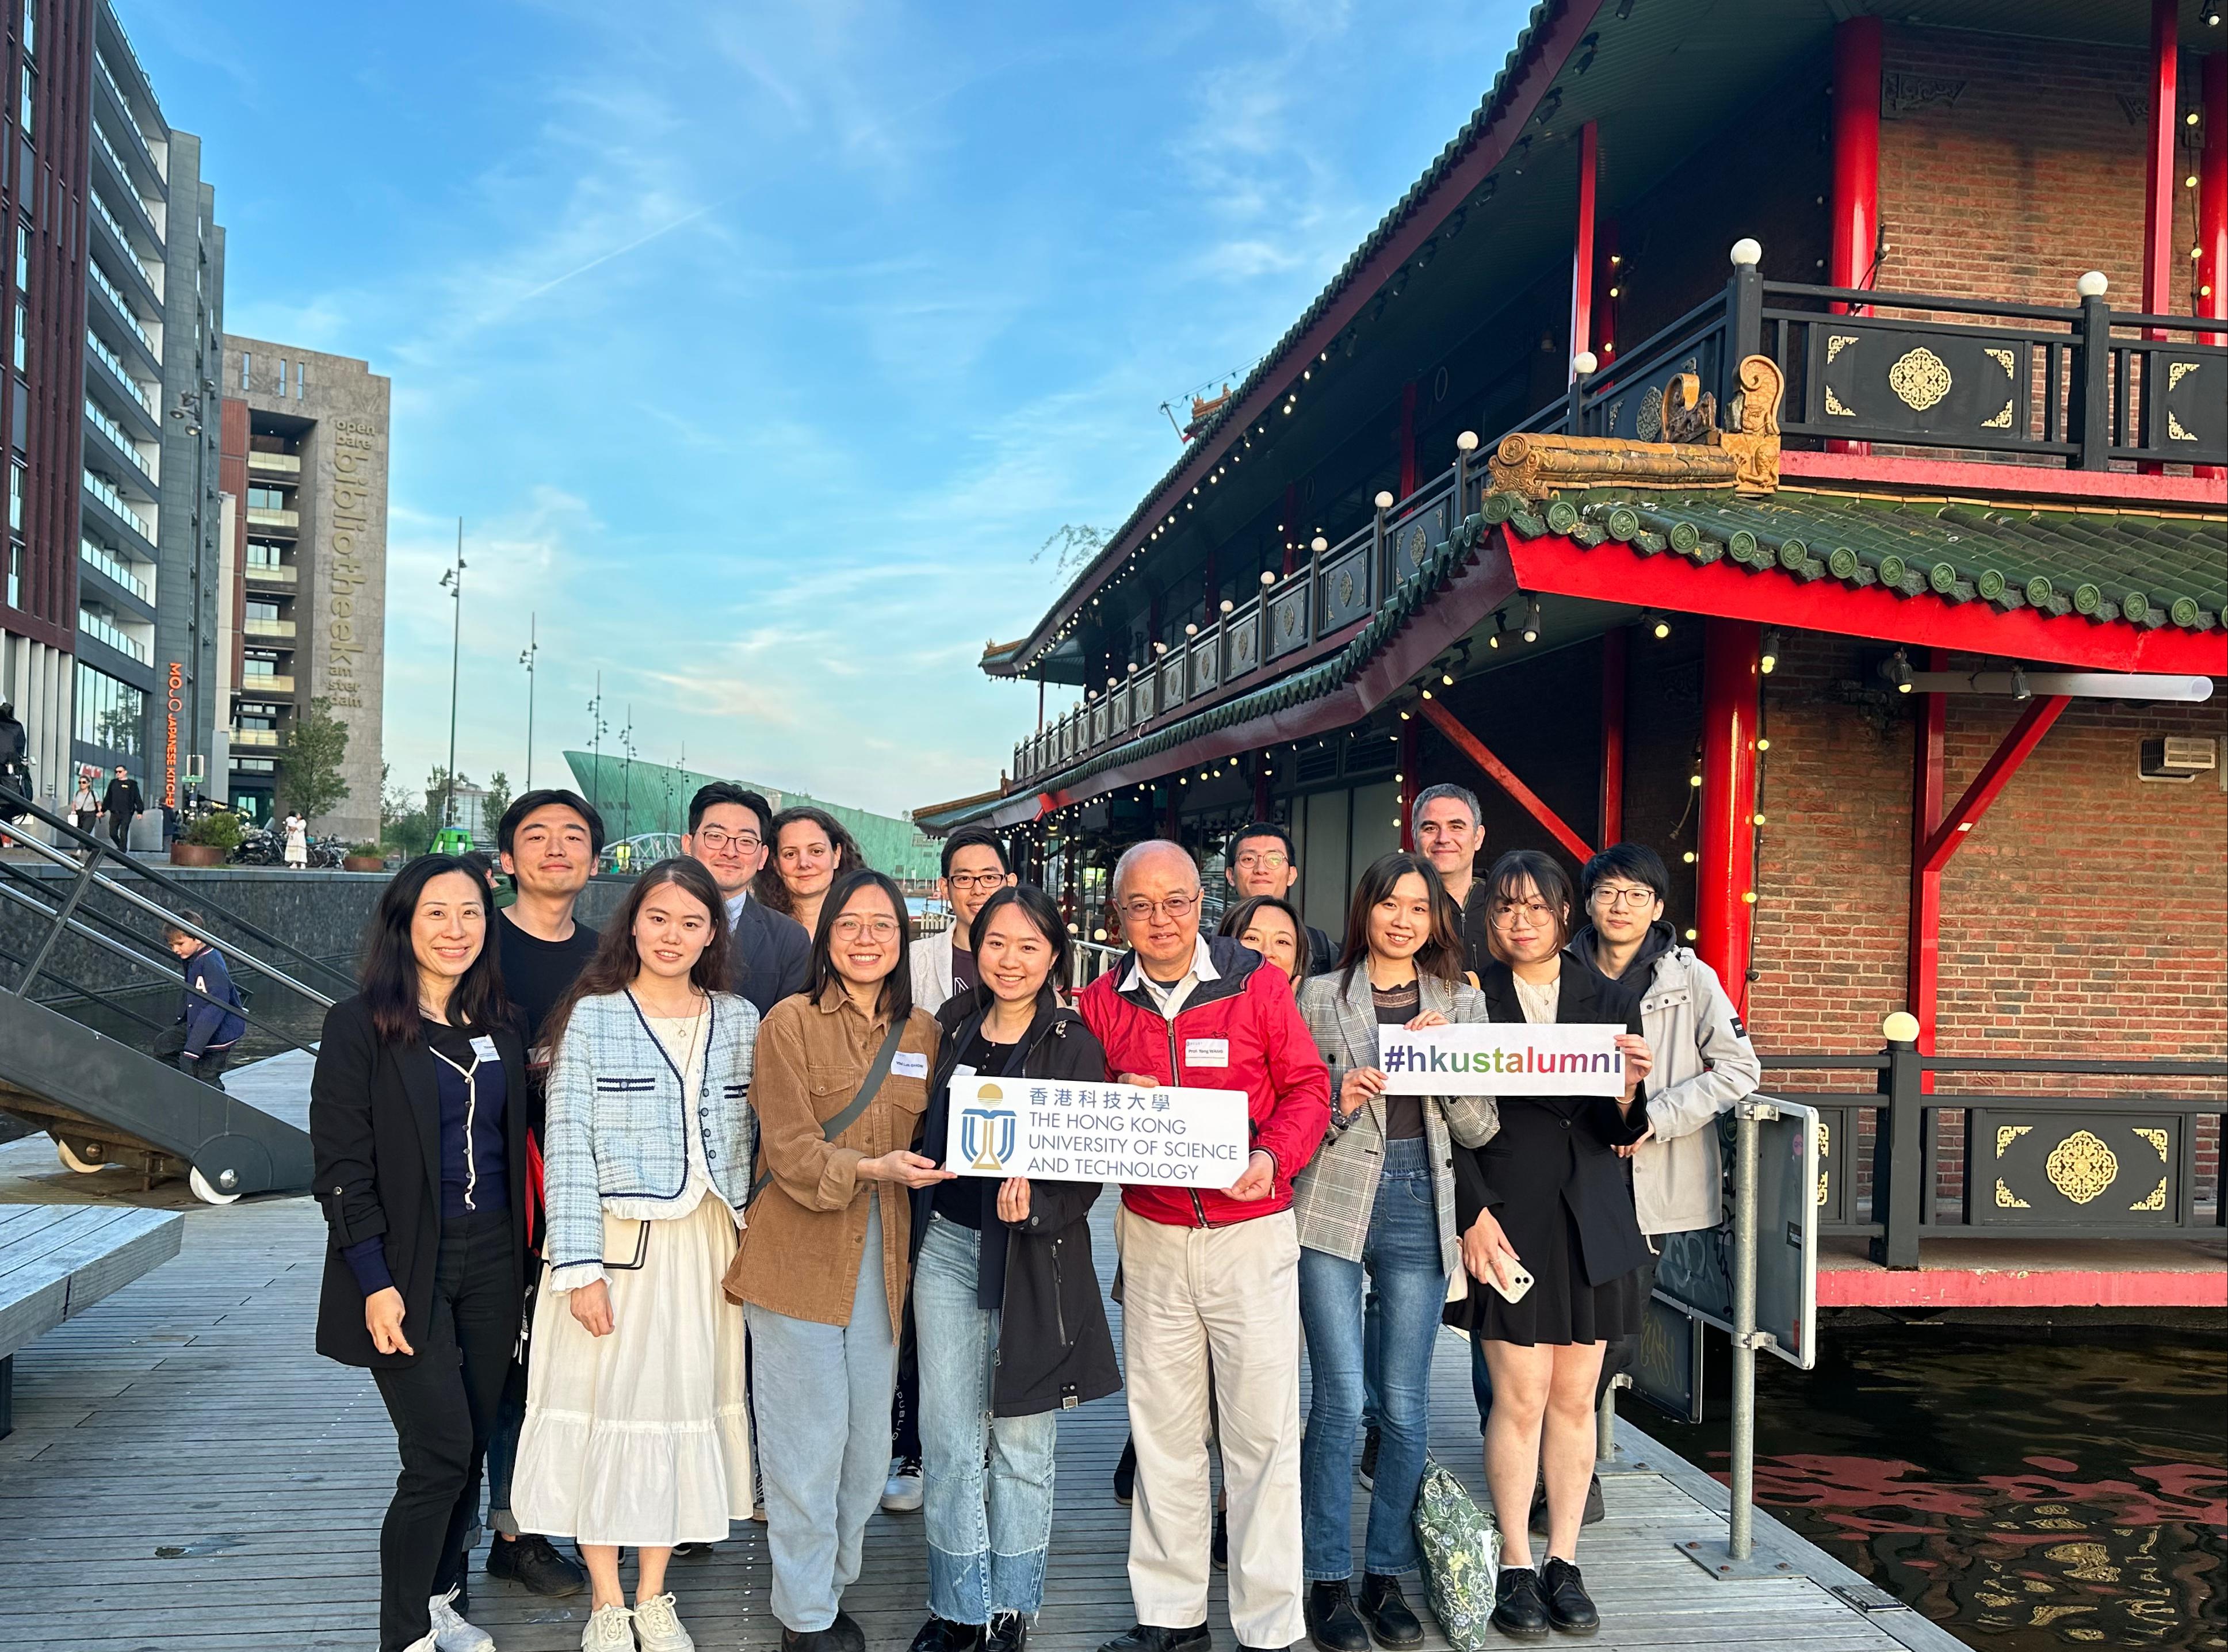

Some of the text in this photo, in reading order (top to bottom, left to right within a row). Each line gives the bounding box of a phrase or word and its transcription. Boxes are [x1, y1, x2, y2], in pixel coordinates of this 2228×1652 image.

[335, 421, 376, 436] open
[335, 431, 371, 450] bare
[330, 448, 369, 665] bibliotheek
[329, 667, 352, 677] am
[168, 663, 182, 712] MOJO
[328, 680, 360, 693] ster
[329, 692, 362, 708] dam
[167, 713, 177, 766] JAPANESE
[196, 976, 207, 993] A
[1385, 1045, 1621, 1073] #hkustalumni
[1029, 1087, 1170, 1112] 香港科技大學
[1029, 1112, 1186, 1135] THE HONG KONG
[1029, 1134, 1238, 1160] UNIVERSITY OF SCIENCE
[1027, 1156, 1199, 1180] AND TECHNOLOGY
